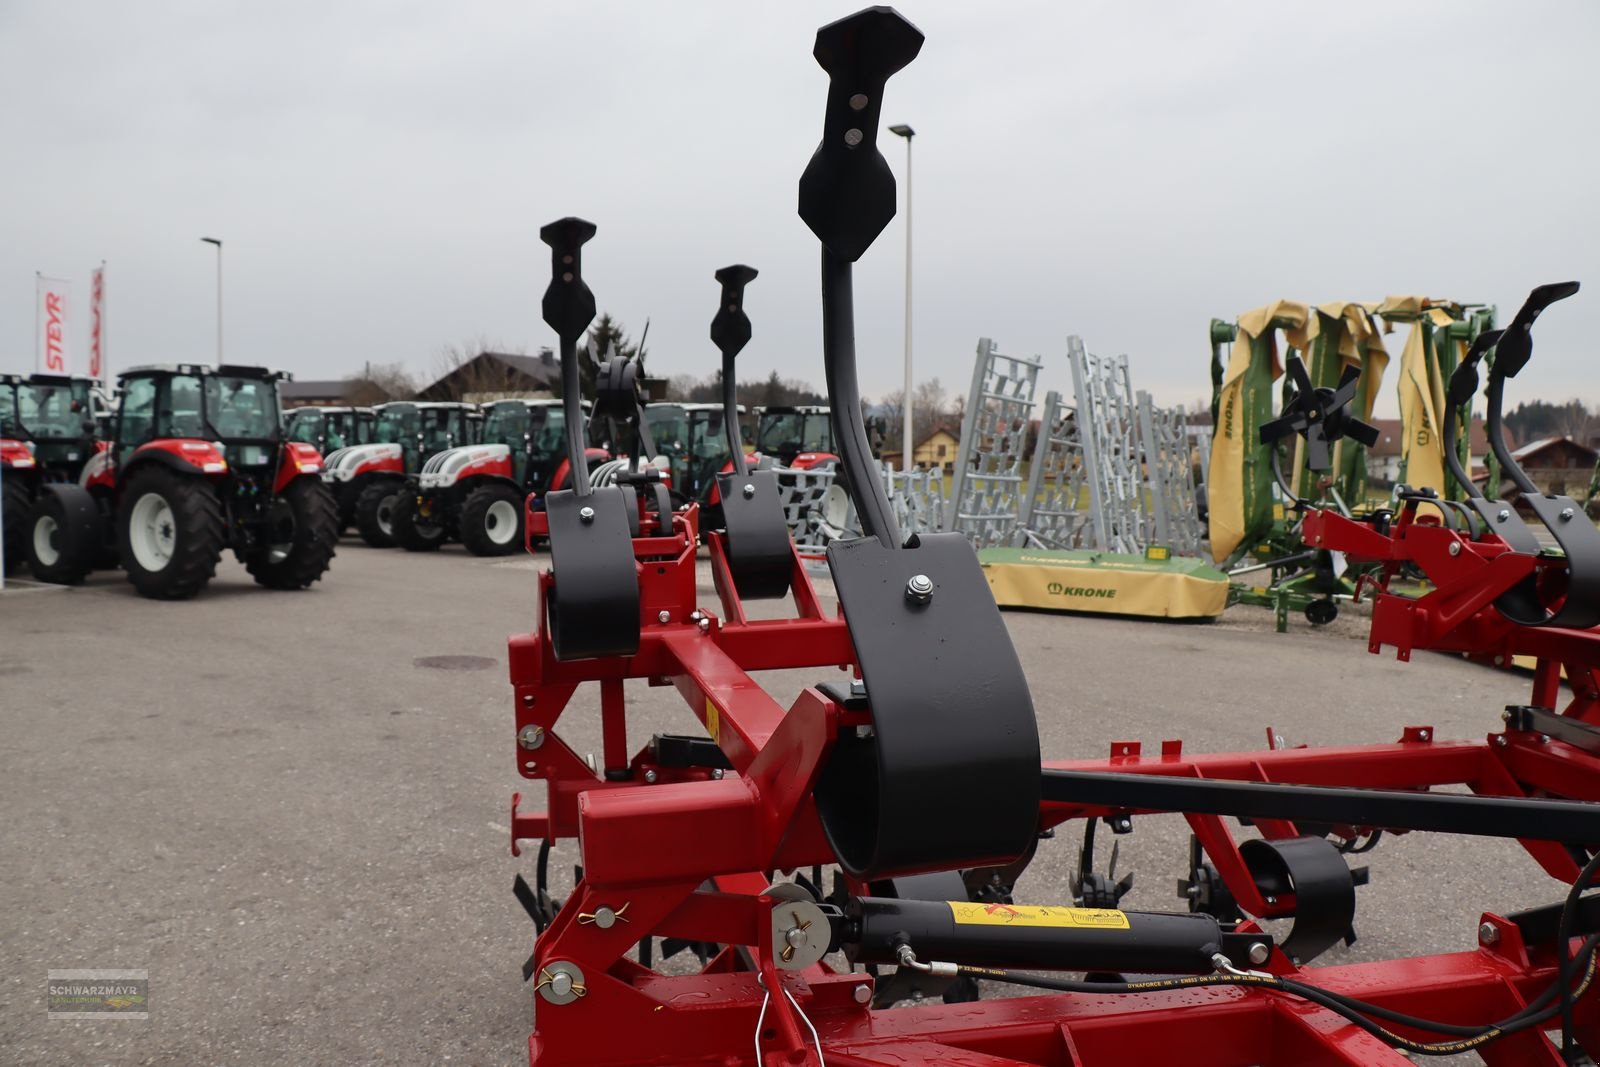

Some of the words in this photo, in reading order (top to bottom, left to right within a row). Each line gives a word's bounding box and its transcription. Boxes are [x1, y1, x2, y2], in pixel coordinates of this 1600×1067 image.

[46, 291, 64, 372] STEYR
[1064, 587, 1117, 598] KRONE
[1127, 981, 1162, 989] DYNAFORCE
